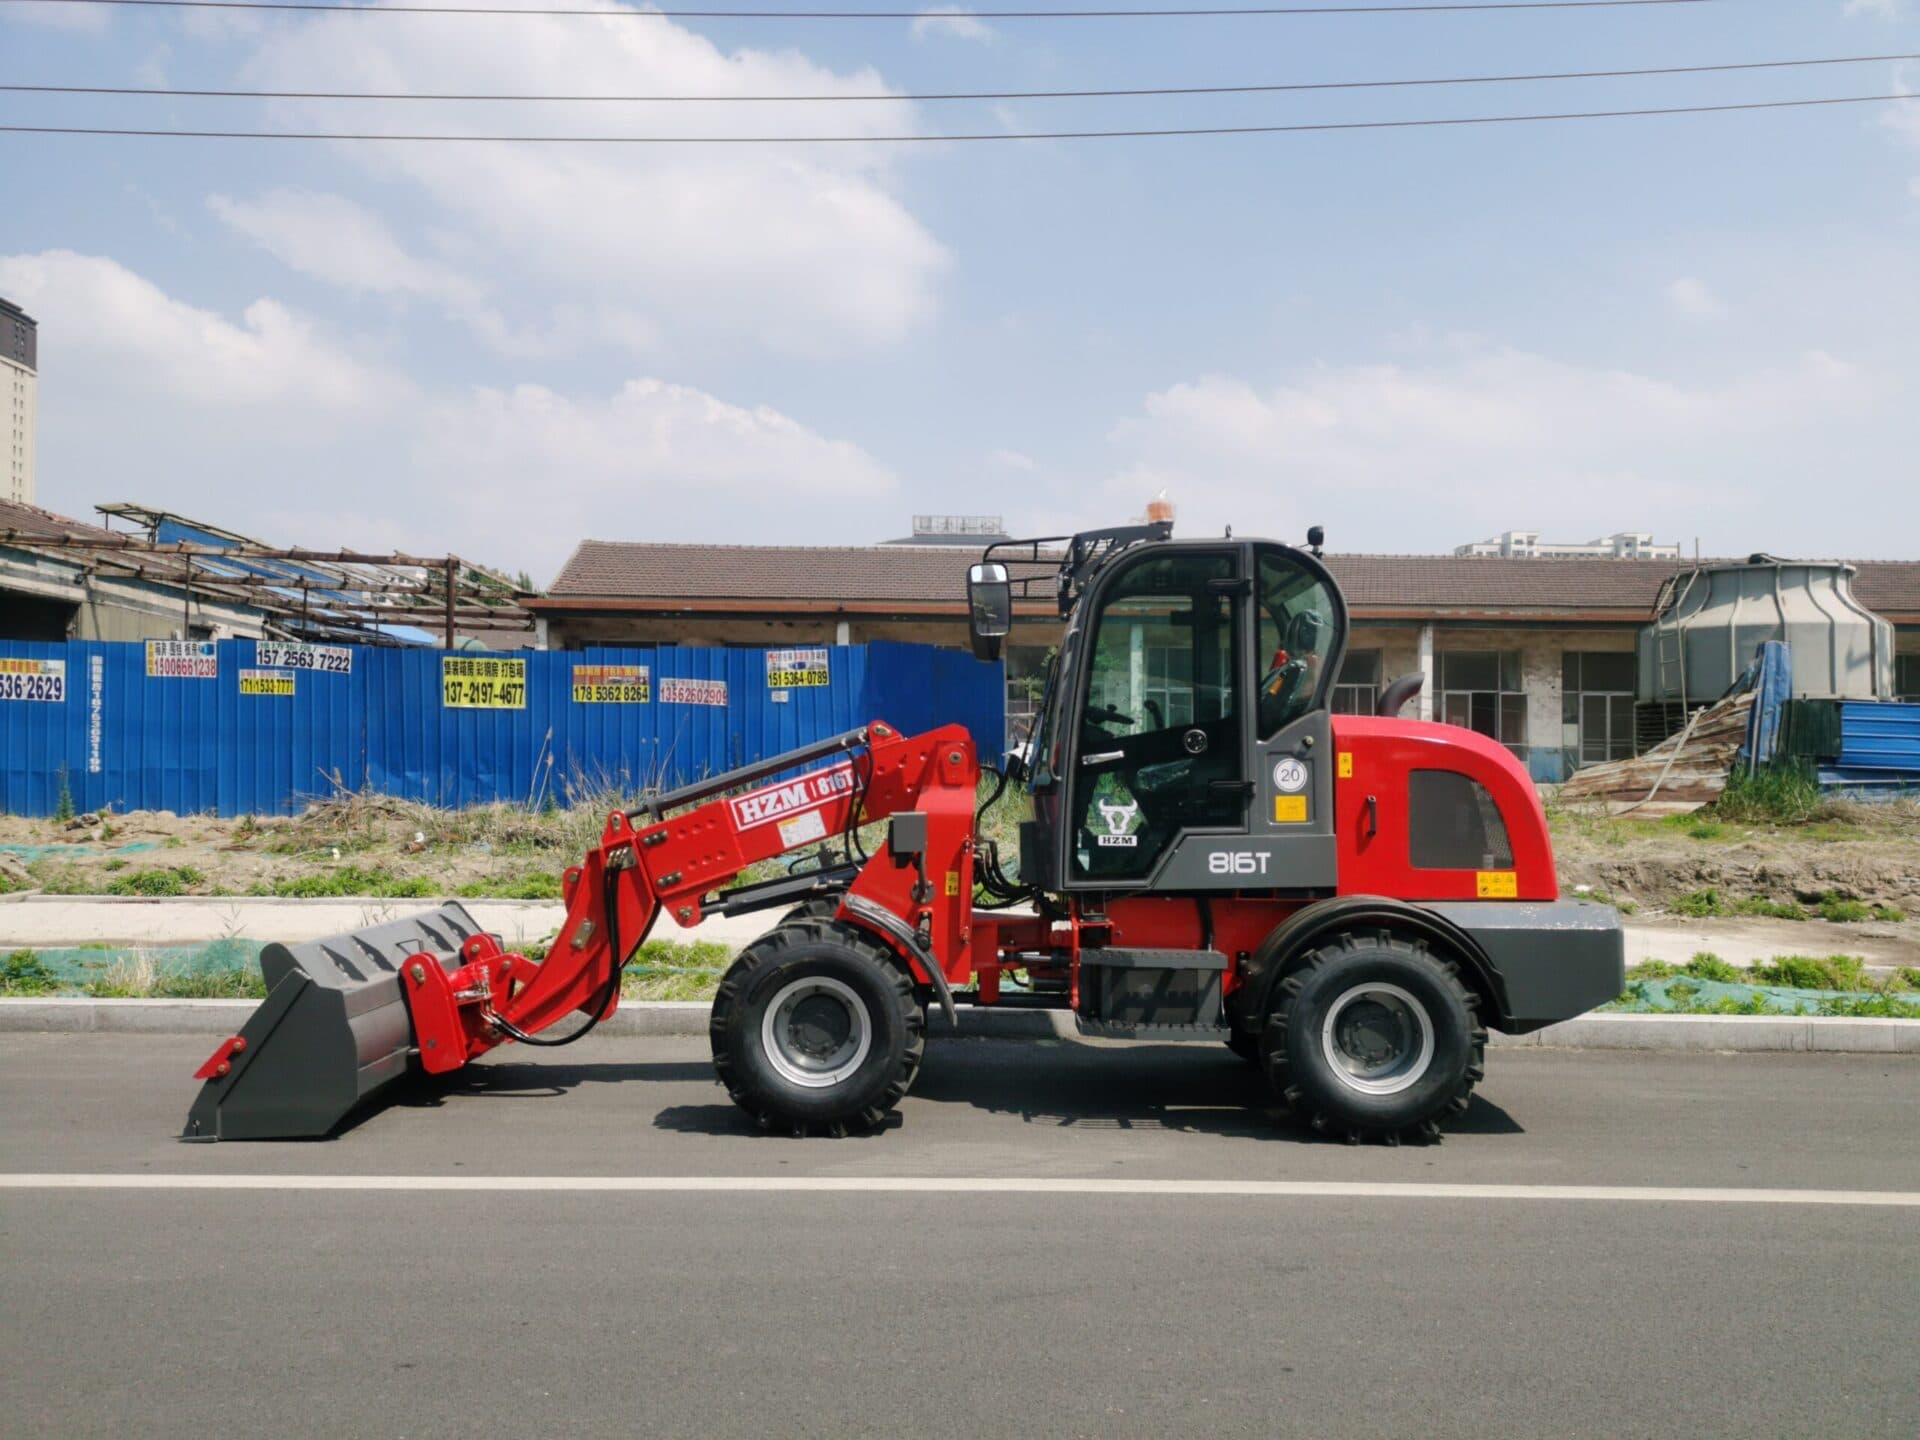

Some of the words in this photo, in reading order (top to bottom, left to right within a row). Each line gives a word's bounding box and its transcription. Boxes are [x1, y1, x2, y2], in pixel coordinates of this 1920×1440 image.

[444, 681, 524, 704] 137-2197-4677
[574, 685, 592, 701] 178
[596, 685, 620, 701] 5362
[623, 685, 648, 701] 8264
[1280, 768, 1301, 782] 20
[738, 782, 811, 824] HZM
[1101, 836, 1134, 845] HZM
[1208, 852, 1272, 874] 816T
